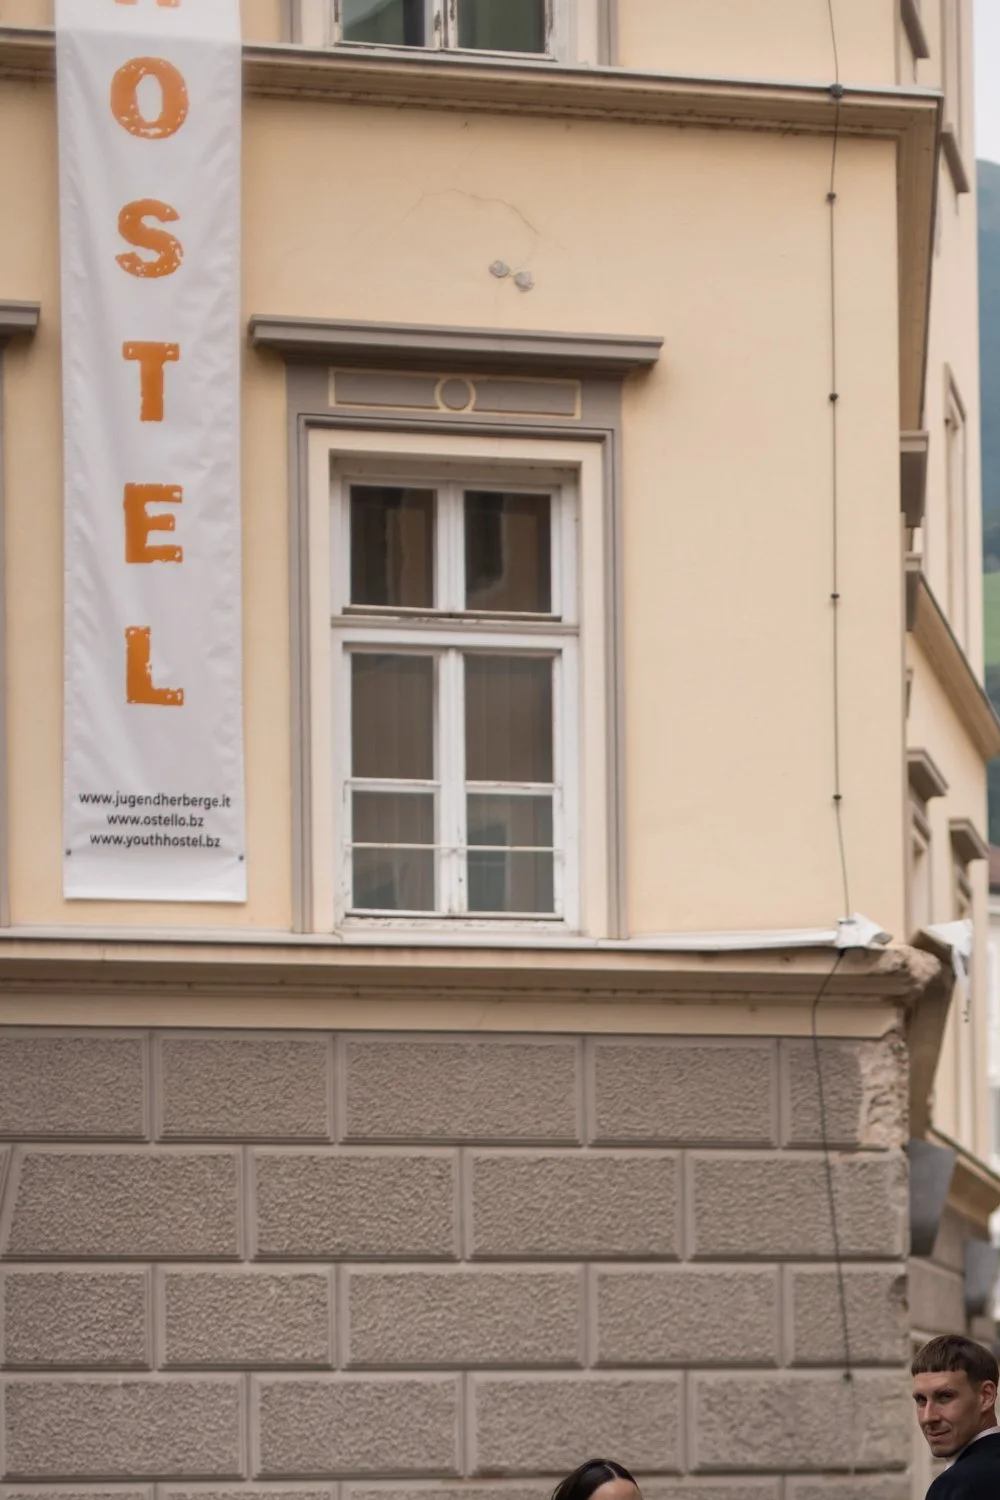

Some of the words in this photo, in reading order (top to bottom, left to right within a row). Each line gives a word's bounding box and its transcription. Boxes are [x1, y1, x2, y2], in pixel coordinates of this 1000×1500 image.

[110, 0, 189, 706] OSTEL
[79, 791, 231, 810] www.jugendherberge.it
[107, 814, 204, 828] www.ostello.bz
[90, 833, 221, 849] www.youthhostel.bz
